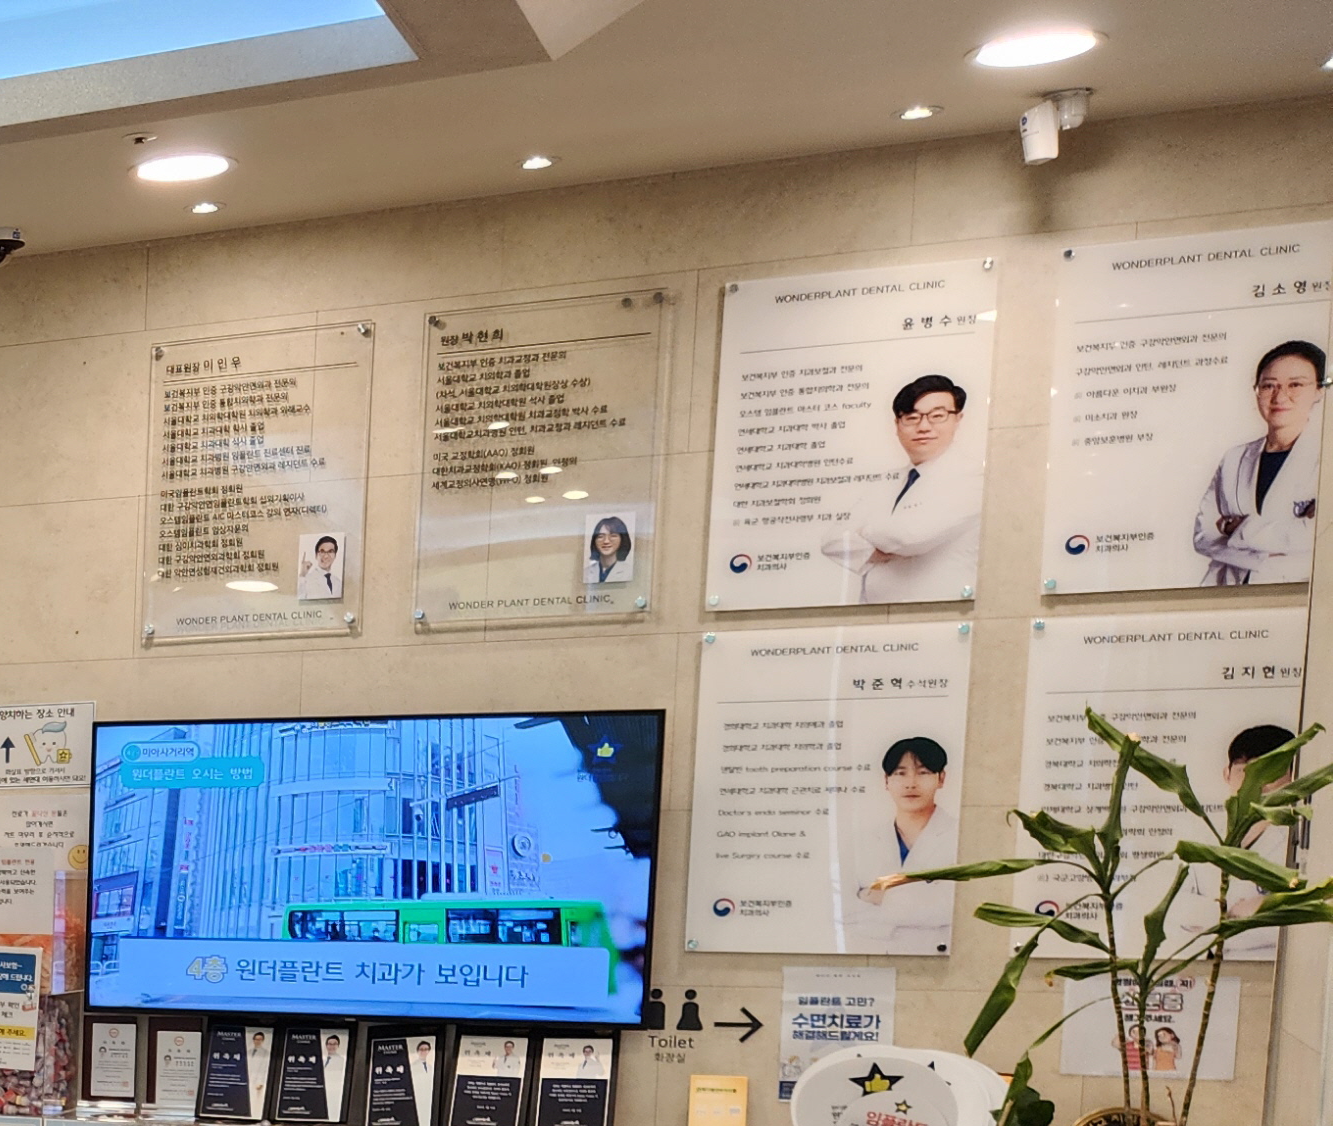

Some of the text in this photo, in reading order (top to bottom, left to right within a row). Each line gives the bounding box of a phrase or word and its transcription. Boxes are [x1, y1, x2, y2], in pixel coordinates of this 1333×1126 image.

[1112, 244, 1300, 271] WONDERPLANT DENTAL CLINIC
[775, 279, 945, 304] WONDERPLANT DENTAL CLINIC
[440, 334, 459, 346] 원장
[438, 351, 567, 371] 보건복지부 인증 치과교정과 전문의
[166, 363, 200, 376] 대표원장
[437, 369, 530, 385] 서울대학교 치의학과 졸업
[164, 387, 200, 399] 보건복지부
[203, 386, 217, 396] 인증
[274, 378, 296, 388] 전문의
[164, 400, 200, 413] 보건복지부
[203, 398, 217, 410] 인증
[266, 392, 289, 402] 전문의
[163, 414, 199, 427] 서울대학교
[202, 409, 246, 424] 치의학대학원
[248, 407, 278, 418] 치의학과
[433, 452, 449, 462] 미국
[511, 446, 535, 456] 정회원
[449, 601, 494, 610] WONDER
[497, 599, 529, 608] PLANT
[533, 597, 572, 607] DENTAL
[176, 610, 322, 626] WONDER PLANT DENTAL CLINIC
[1084, 629, 1269, 645] WONDERPLANT DENTAL CLINIC
[751, 642, 919, 656] WONDERPLANT DENTAL CLINIC
[0, 707, 75, 720] 양치하는 장소 안내
[142, 747, 194, 758] 미아사거리역
[132, 767, 253, 781] 원더플란트 오시는 방법
[186, 954, 529, 988] 4층 원더플란트 치과가 보입니다
[798, 996, 875, 1007] 임플란트 고민?
[792, 1013, 881, 1029] 수면치료가
[648, 1035, 694, 1048] Toilet
[655, 1053, 686, 1063] 화장실
